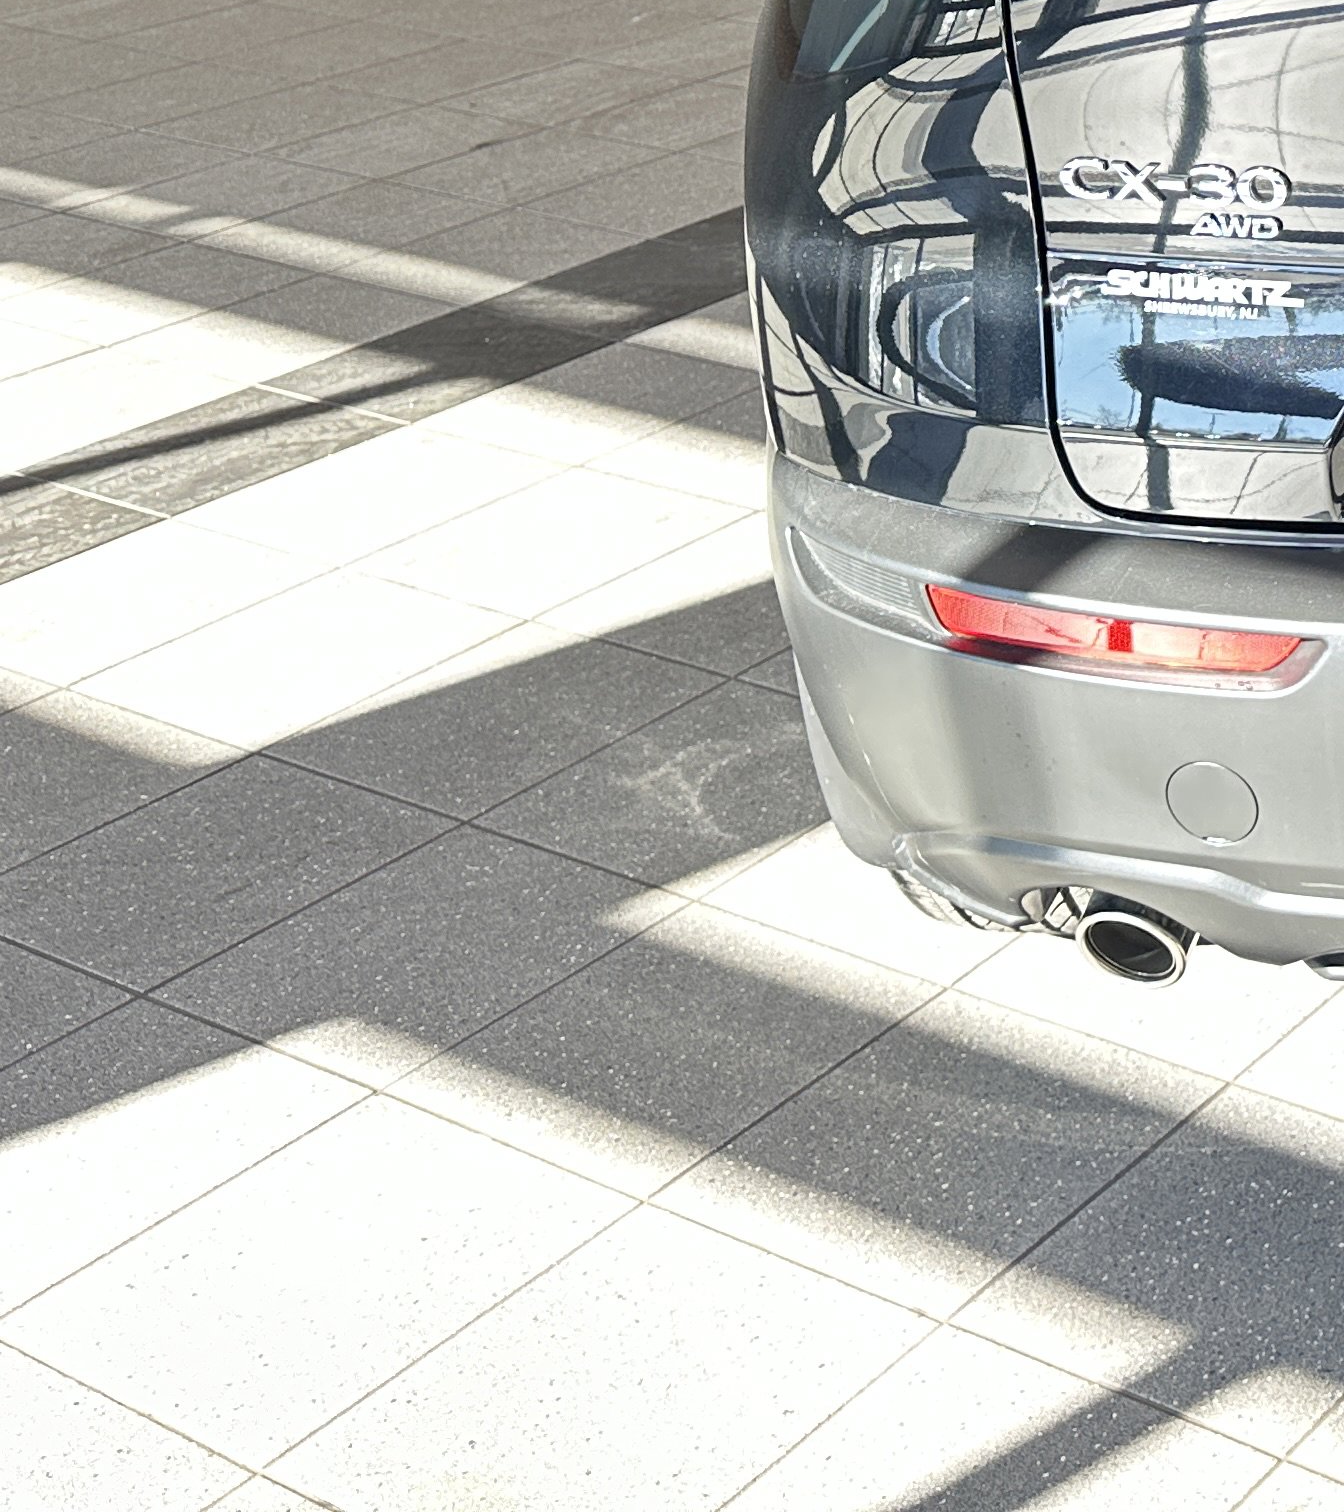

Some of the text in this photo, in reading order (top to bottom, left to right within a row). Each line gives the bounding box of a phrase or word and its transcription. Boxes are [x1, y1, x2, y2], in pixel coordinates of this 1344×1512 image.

[1059, 156, 1292, 211] CX-30
[1191, 212, 1284, 240] AWD
[1101, 269, 1304, 308] SCHWARTZ
